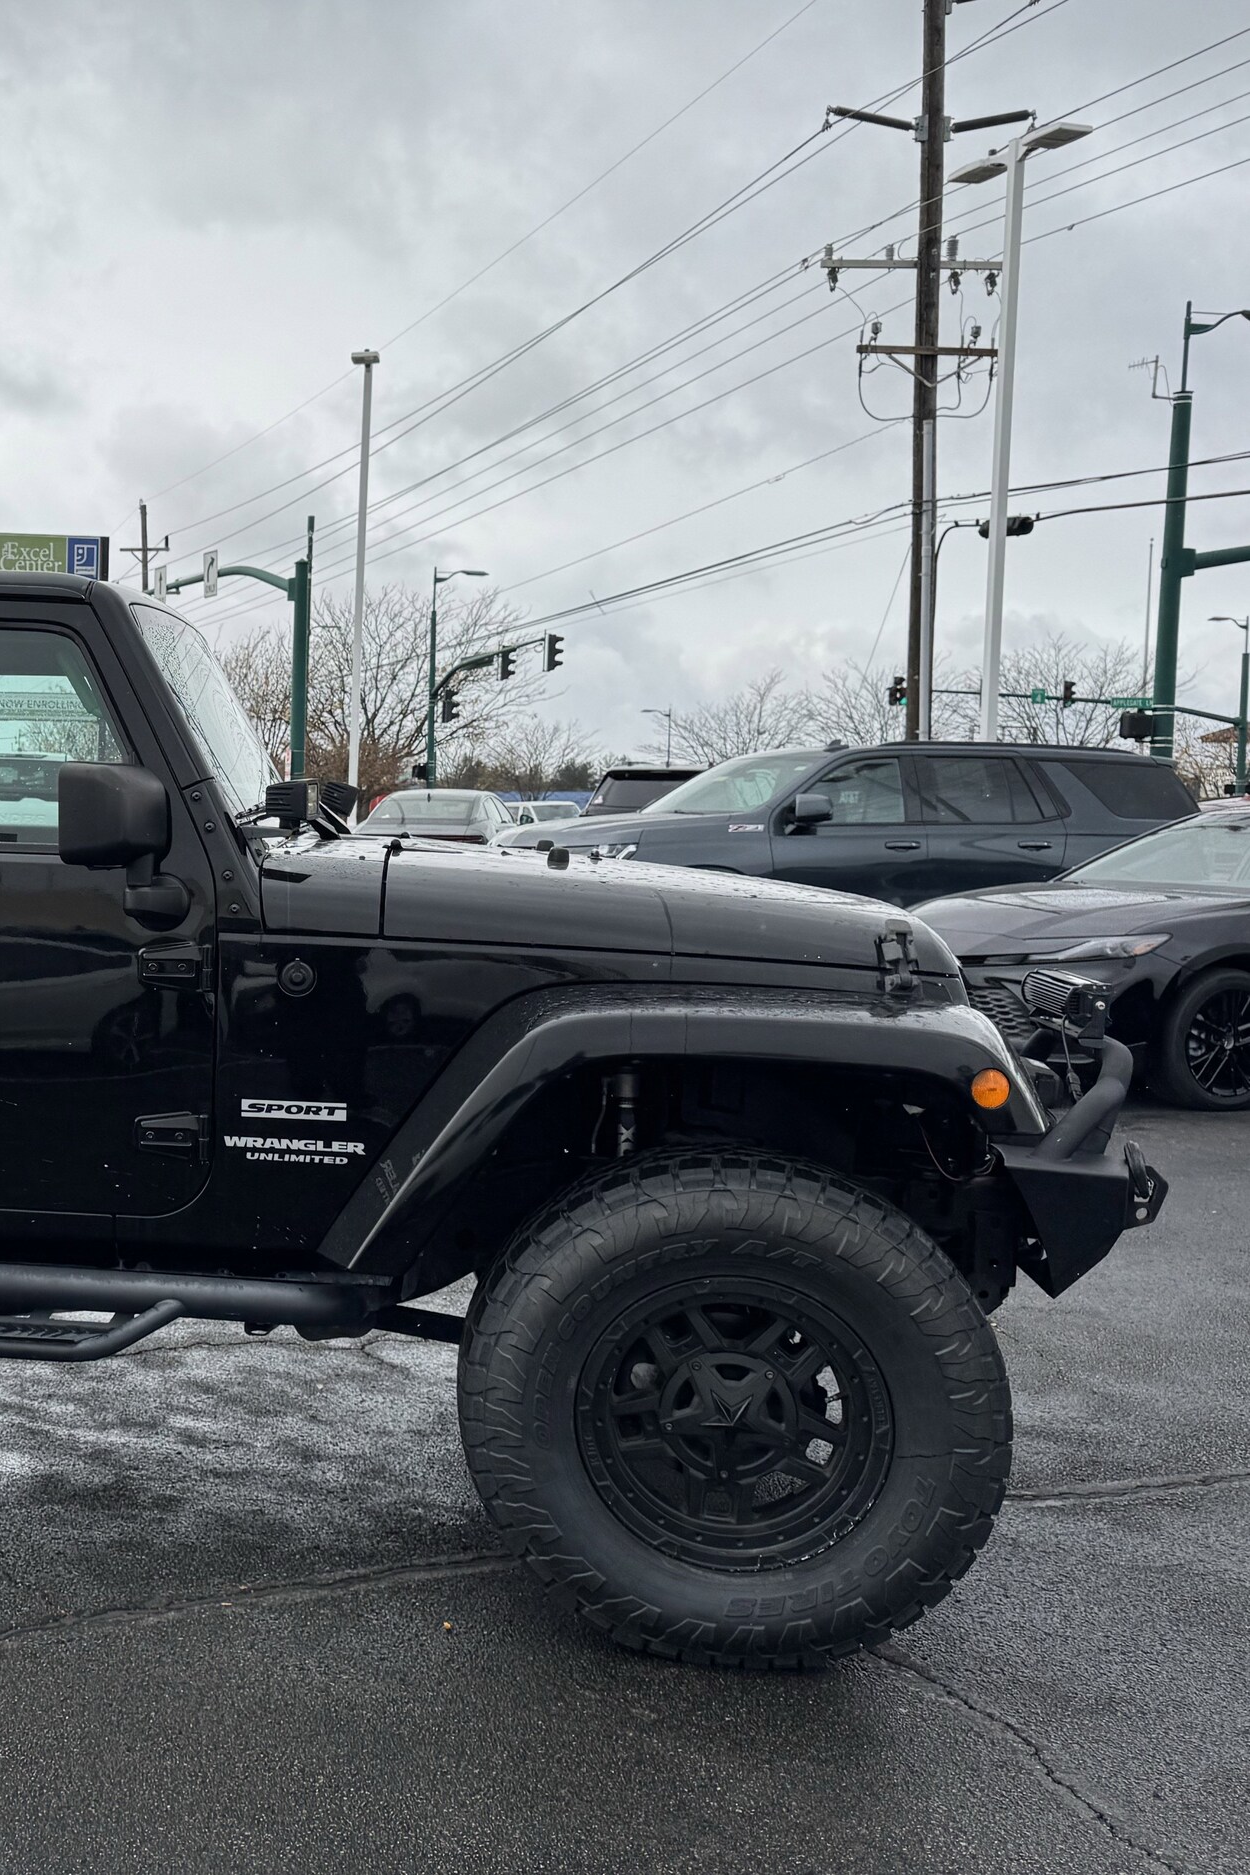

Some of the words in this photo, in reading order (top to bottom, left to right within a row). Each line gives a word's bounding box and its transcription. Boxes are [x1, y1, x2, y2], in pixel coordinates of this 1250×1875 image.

[6, 542, 54, 561] Excel
[0, 555, 62, 572] Center
[246, 1102, 343, 1117] SPORT
[223, 1135, 366, 1156] WRANGLER
[245, 1151, 349, 1165] UNLIMITED
